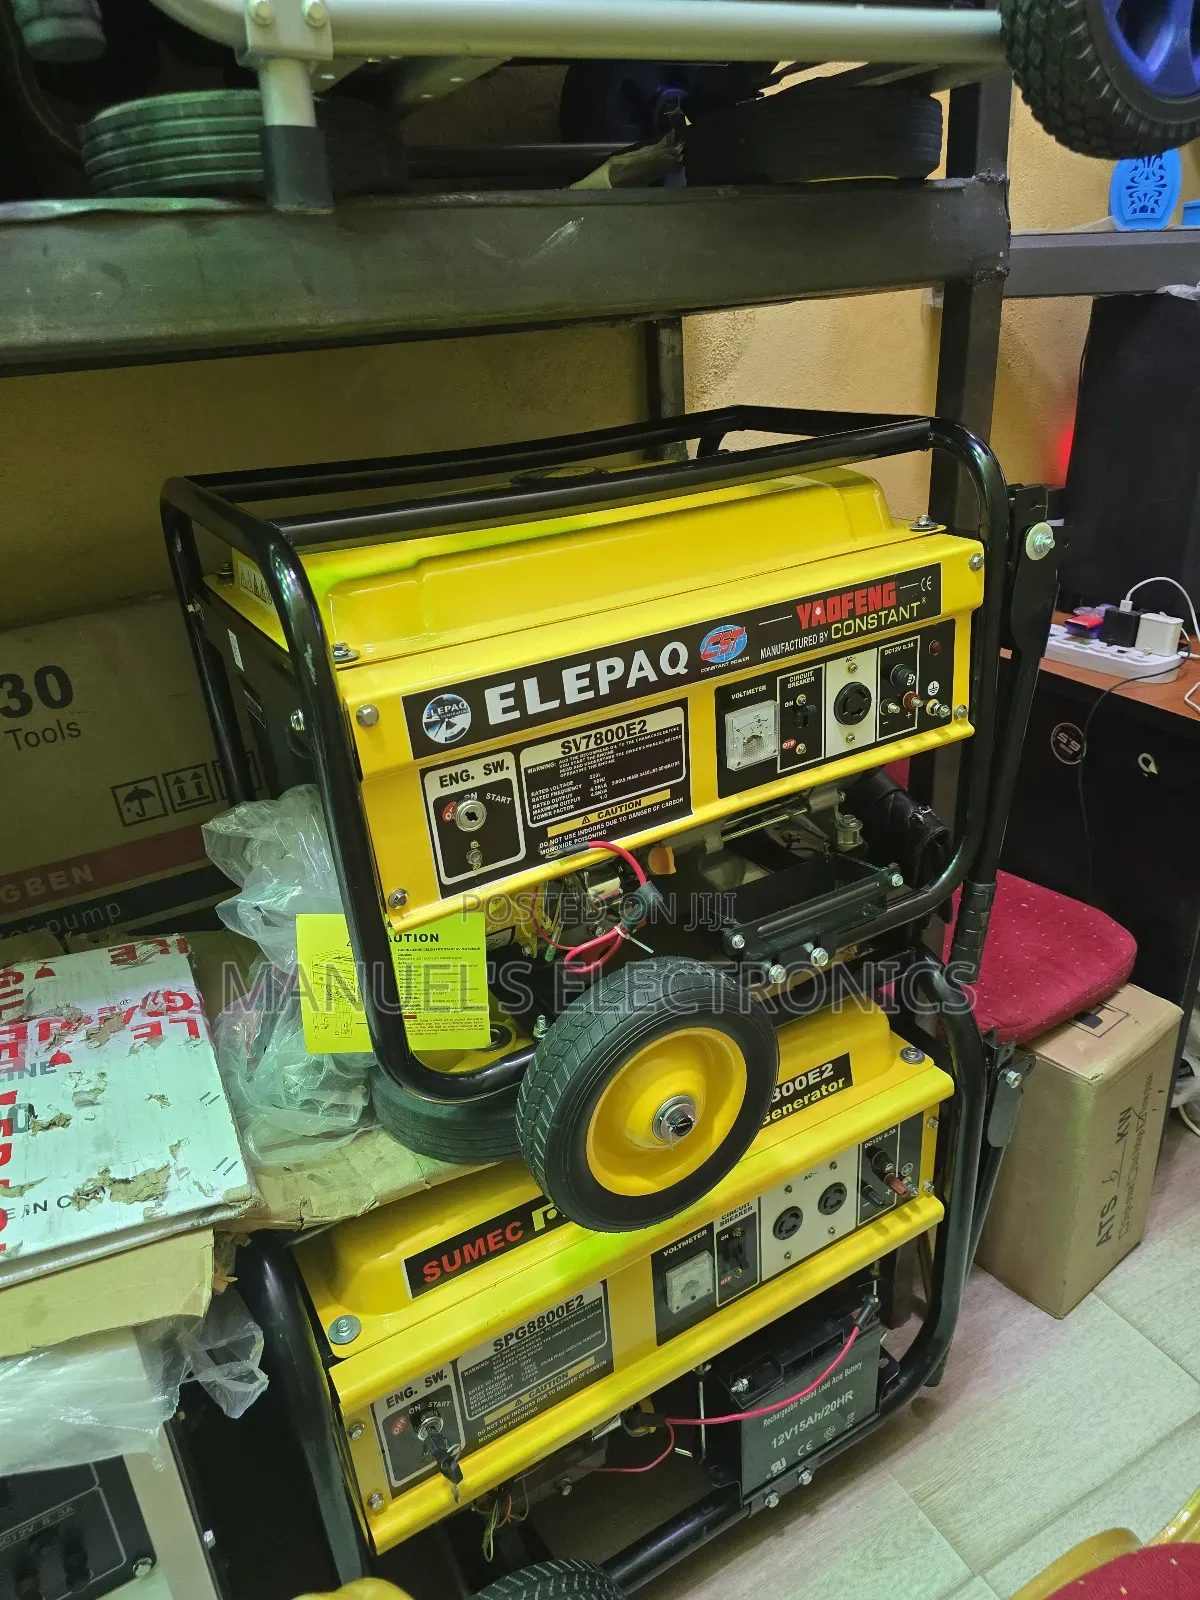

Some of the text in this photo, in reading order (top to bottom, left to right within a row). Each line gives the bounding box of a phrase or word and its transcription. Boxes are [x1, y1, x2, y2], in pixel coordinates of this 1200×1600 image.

[796, 581, 897, 630] YAOFENG
[701, 627, 746, 660] CST
[760, 638, 818, 660] MANUFACTURED
[819, 631, 829, 644] BY
[484, 640, 689, 725] ELEPAQ
[787, 676, 815, 689] BREAKER
[789, 671, 814, 683] CIRCUIT
[731, 684, 767, 700] VOLTMETER
[426, 701, 467, 718] ELEPAQ
[5, 719, 82, 751] Tools
[560, 720, 648, 755] SV7800E2
[782, 739, 796, 749] OFF
[439, 759, 510, 789] ENG. SW.
[485, 792, 513, 804] START
[597, 798, 642, 820] CAUTION
[539, 796, 683, 848] DO NOT USE INDOORS DUE TO DANGER OF CARBON
[539, 839, 573, 856] MONOXIDE
[0, 864, 95, 904] GBEN
[46, 902, 122, 934] pump
[390, 933, 440, 943] UTION
[864, 1135, 883, 1149] DC12V
[1096, 1195, 1118, 1247] ATS
[1115, 1105, 1133, 1144] KW
[720, 1205, 753, 1227] BREAKER
[721, 1202, 751, 1220] CIRCUIT
[422, 1221, 524, 1283] SUMEC
[662, 1229, 708, 1257] VOLTMETER
[720, 1275, 732, 1285] OFF
[493, 1294, 585, 1353] SPG8800E2
[385, 1369, 448, 1410] ENG. SW.
[477, 1428, 485, 1437] DO
[485, 1420, 498, 1432] NOT
[499, 1413, 510, 1424] USE
[511, 1399, 535, 1418] INDOORS
[548, 1388, 555, 1396] TO
[556, 1374, 577, 1392] DANGER
[578, 1370, 585, 1379] OF
[586, 1358, 606, 1375] CARBON
[528, 1370, 569, 1400] CAUTION
[763, 1362, 863, 1428] Rechargeable Sealed Lead Acid Battery
[408, 1400, 452, 1415] ON START
[393, 1415, 406, 1434] OFF
